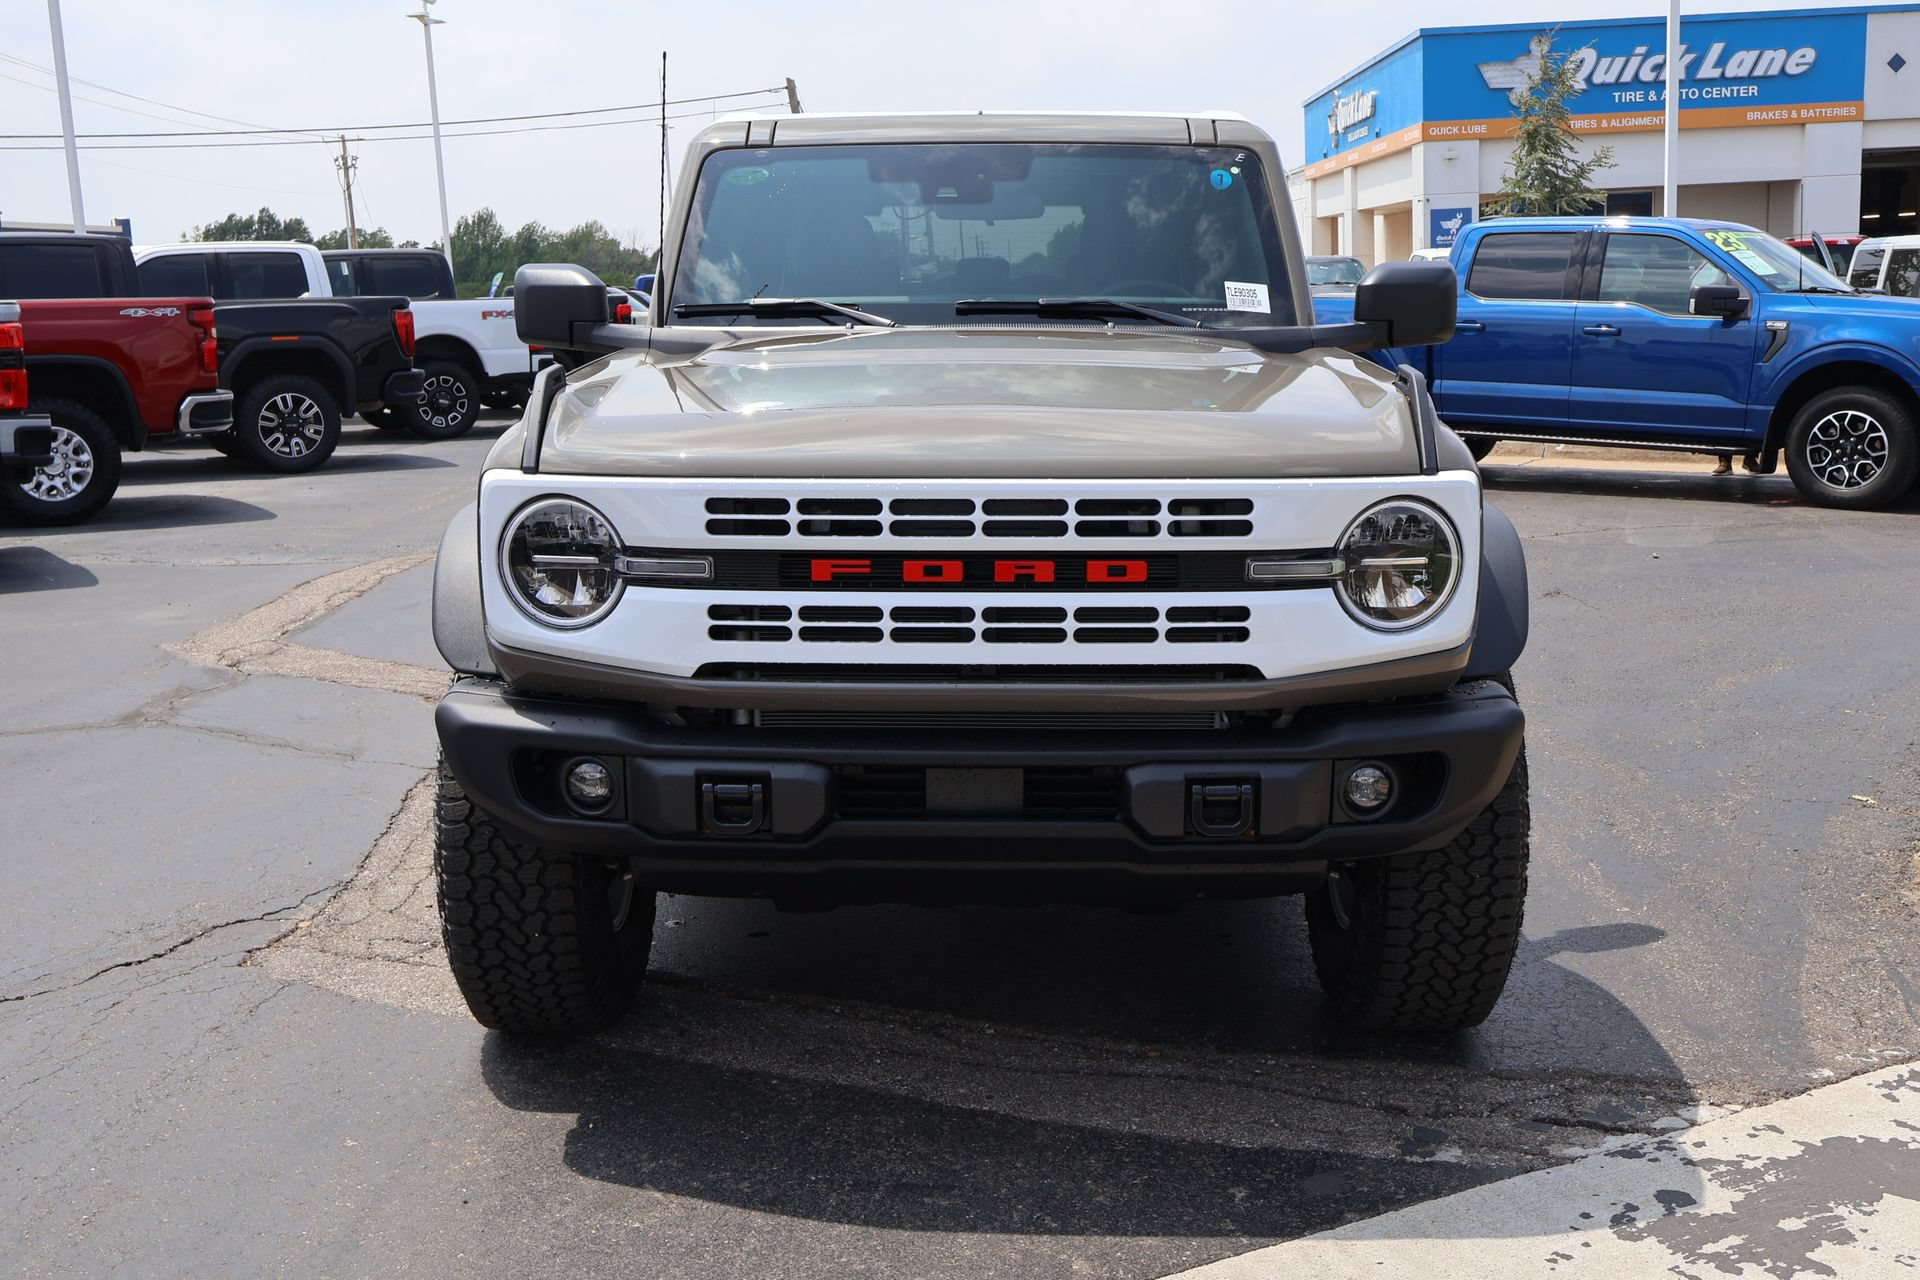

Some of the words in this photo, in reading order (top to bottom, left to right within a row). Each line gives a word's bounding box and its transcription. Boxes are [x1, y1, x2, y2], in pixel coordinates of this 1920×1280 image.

[1695, 42, 1817, 81] Lane
[1612, 91, 1644, 103] TIRE
[1648, 90, 1657, 101] &
[1660, 88, 1699, 101] ATO
[1702, 85, 1758, 98] CENTER
[1746, 111, 1788, 120] BRAKES
[1790, 110, 1798, 118] &
[1800, 107, 1857, 118] BATTERIES
[1429, 126, 1461, 136] QUICK
[1461, 124, 1488, 134] LUBE
[1569, 119, 1598, 129] TIRES
[1601, 118, 1609, 128] &
[1704, 231, 1749, 251] 23
[811, 560, 1147, 583] FORD
